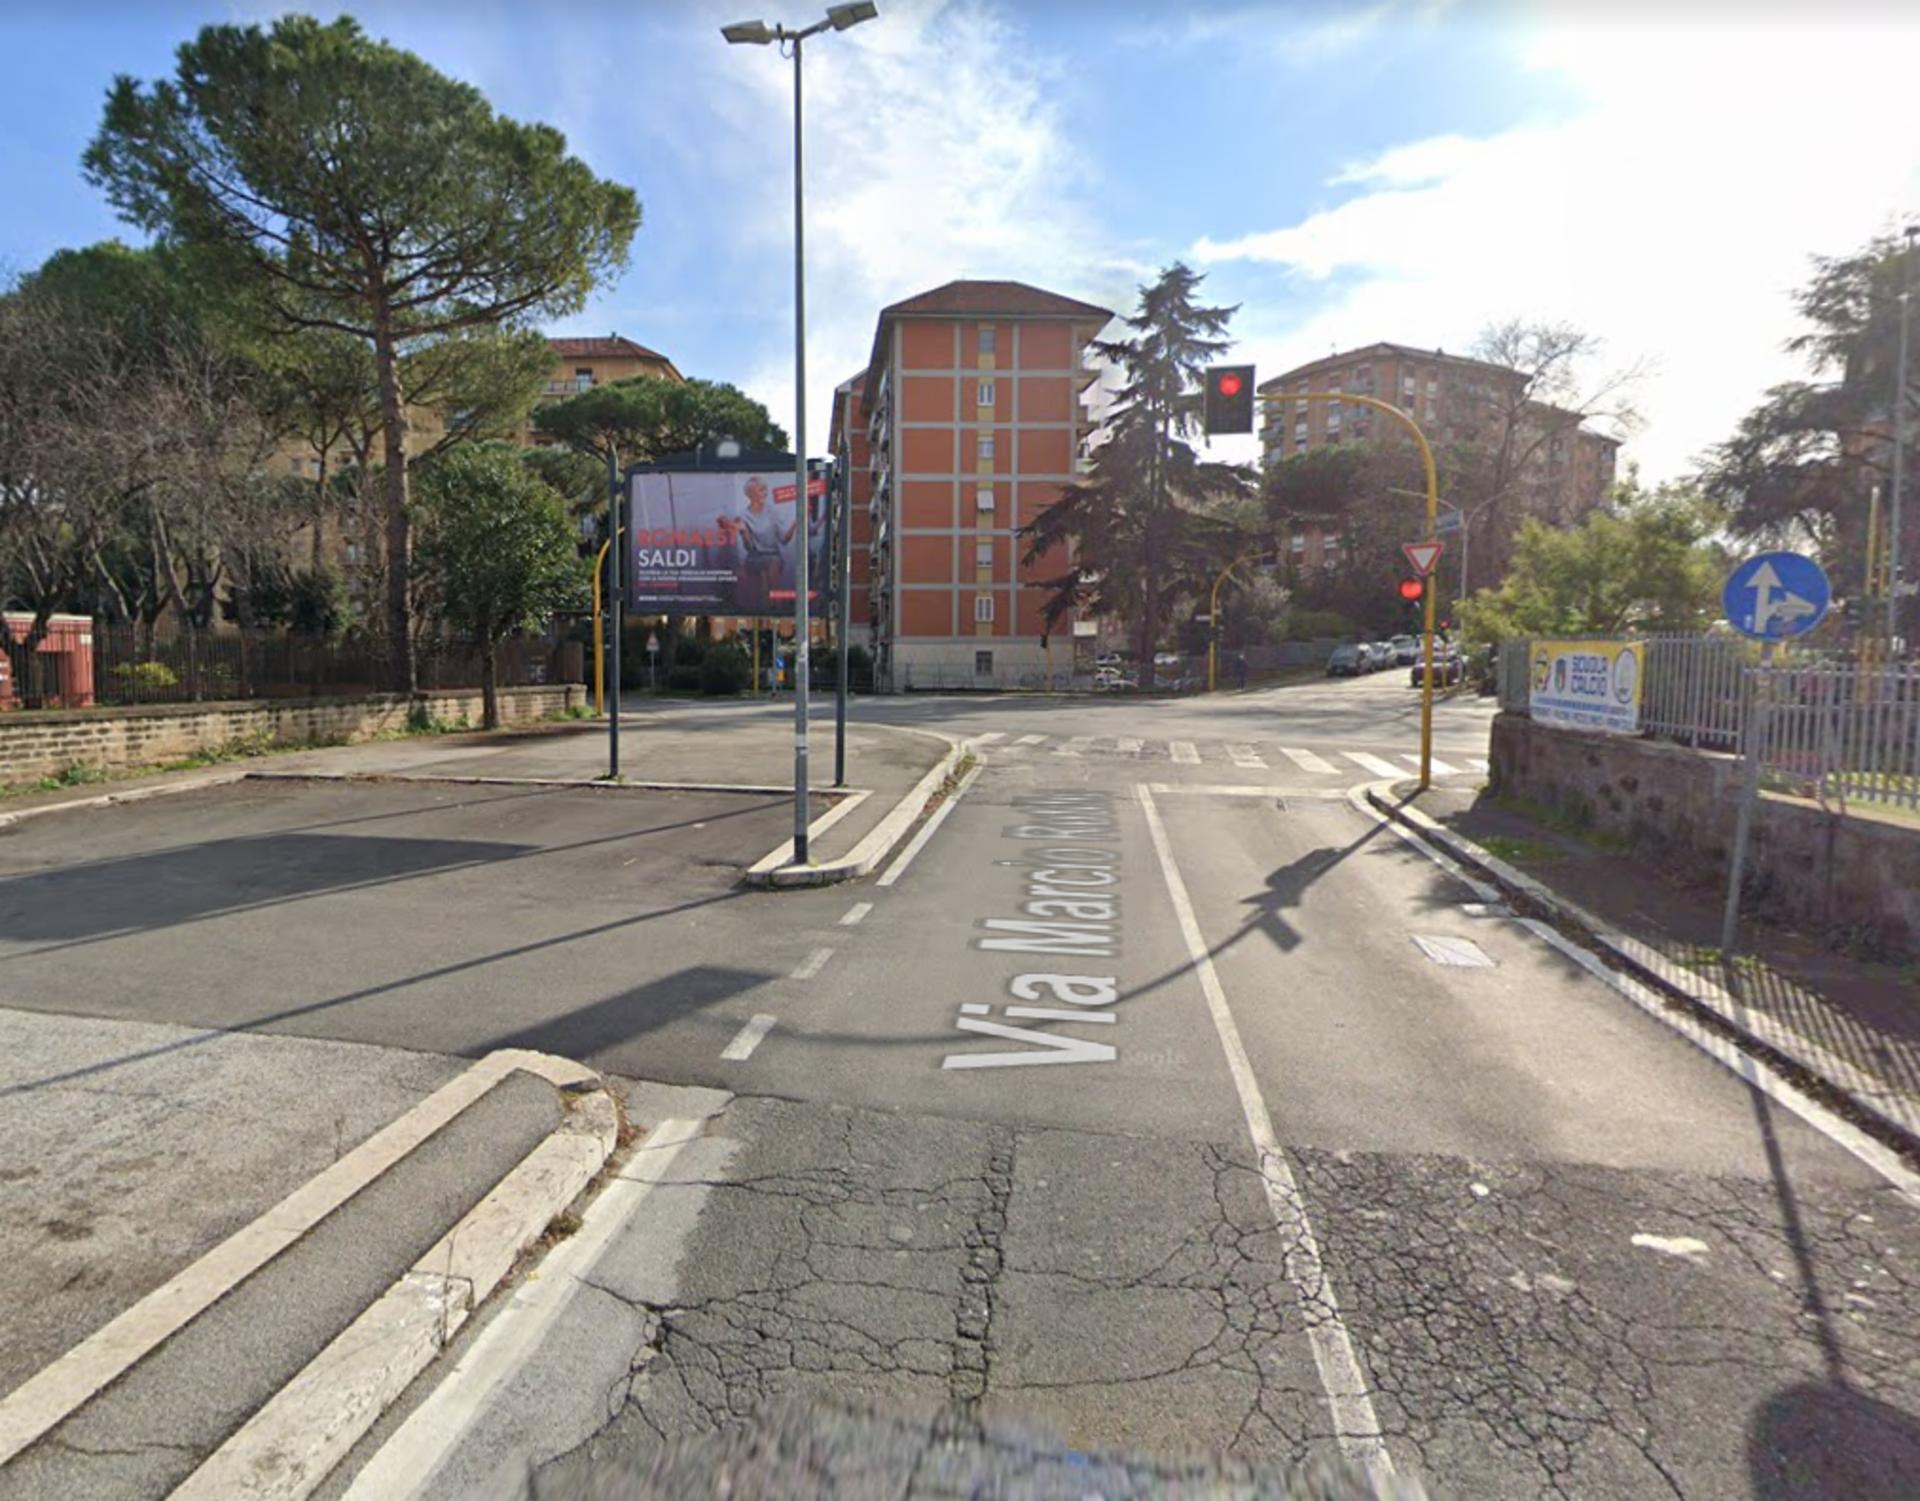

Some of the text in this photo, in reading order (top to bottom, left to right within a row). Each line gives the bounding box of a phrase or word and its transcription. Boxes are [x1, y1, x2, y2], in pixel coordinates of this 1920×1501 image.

[638, 549, 697, 566] SALDI
[1572, 655, 1608, 674] SCUOLA
[1571, 675, 1608, 697] CALCIO
